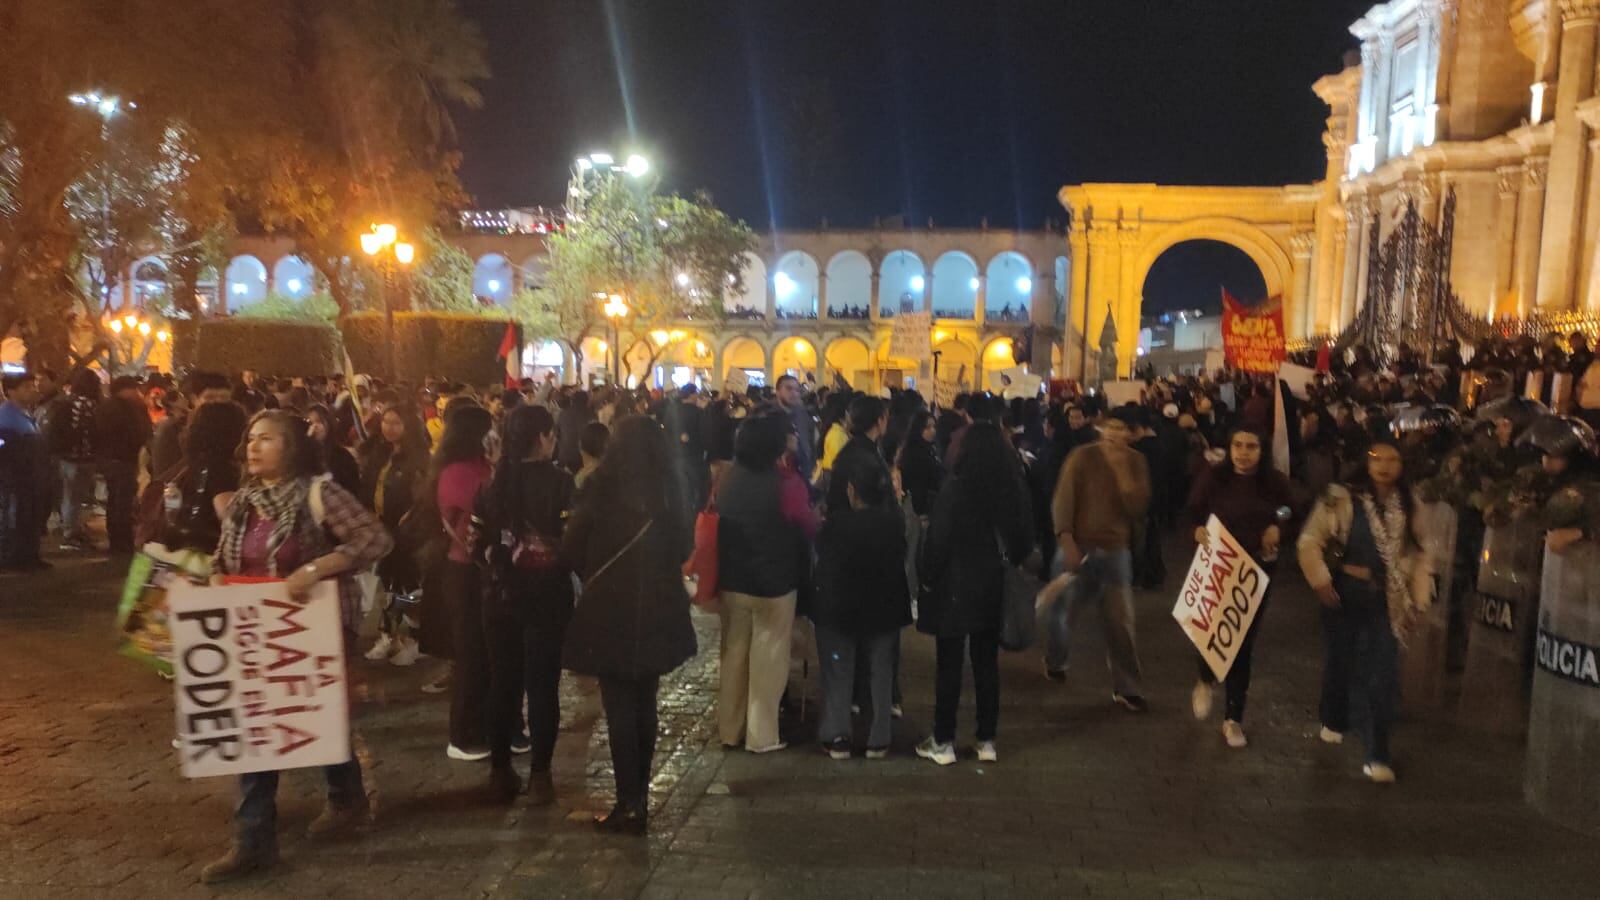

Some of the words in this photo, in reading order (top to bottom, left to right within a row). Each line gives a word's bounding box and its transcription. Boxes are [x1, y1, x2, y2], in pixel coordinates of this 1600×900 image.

[1184, 569, 1203, 608] QUE
[1200, 545, 1213, 568] SE
[1191, 537, 1240, 632] VAYAN
[1207, 560, 1260, 662] TODOS
[234, 606, 261, 680] SIGUE
[262, 598, 321, 756] MAFIA
[314, 655, 338, 688] LA
[176, 608, 241, 762] PODER
[241, 690, 269, 718] EN
[247, 726, 272, 757] EL
